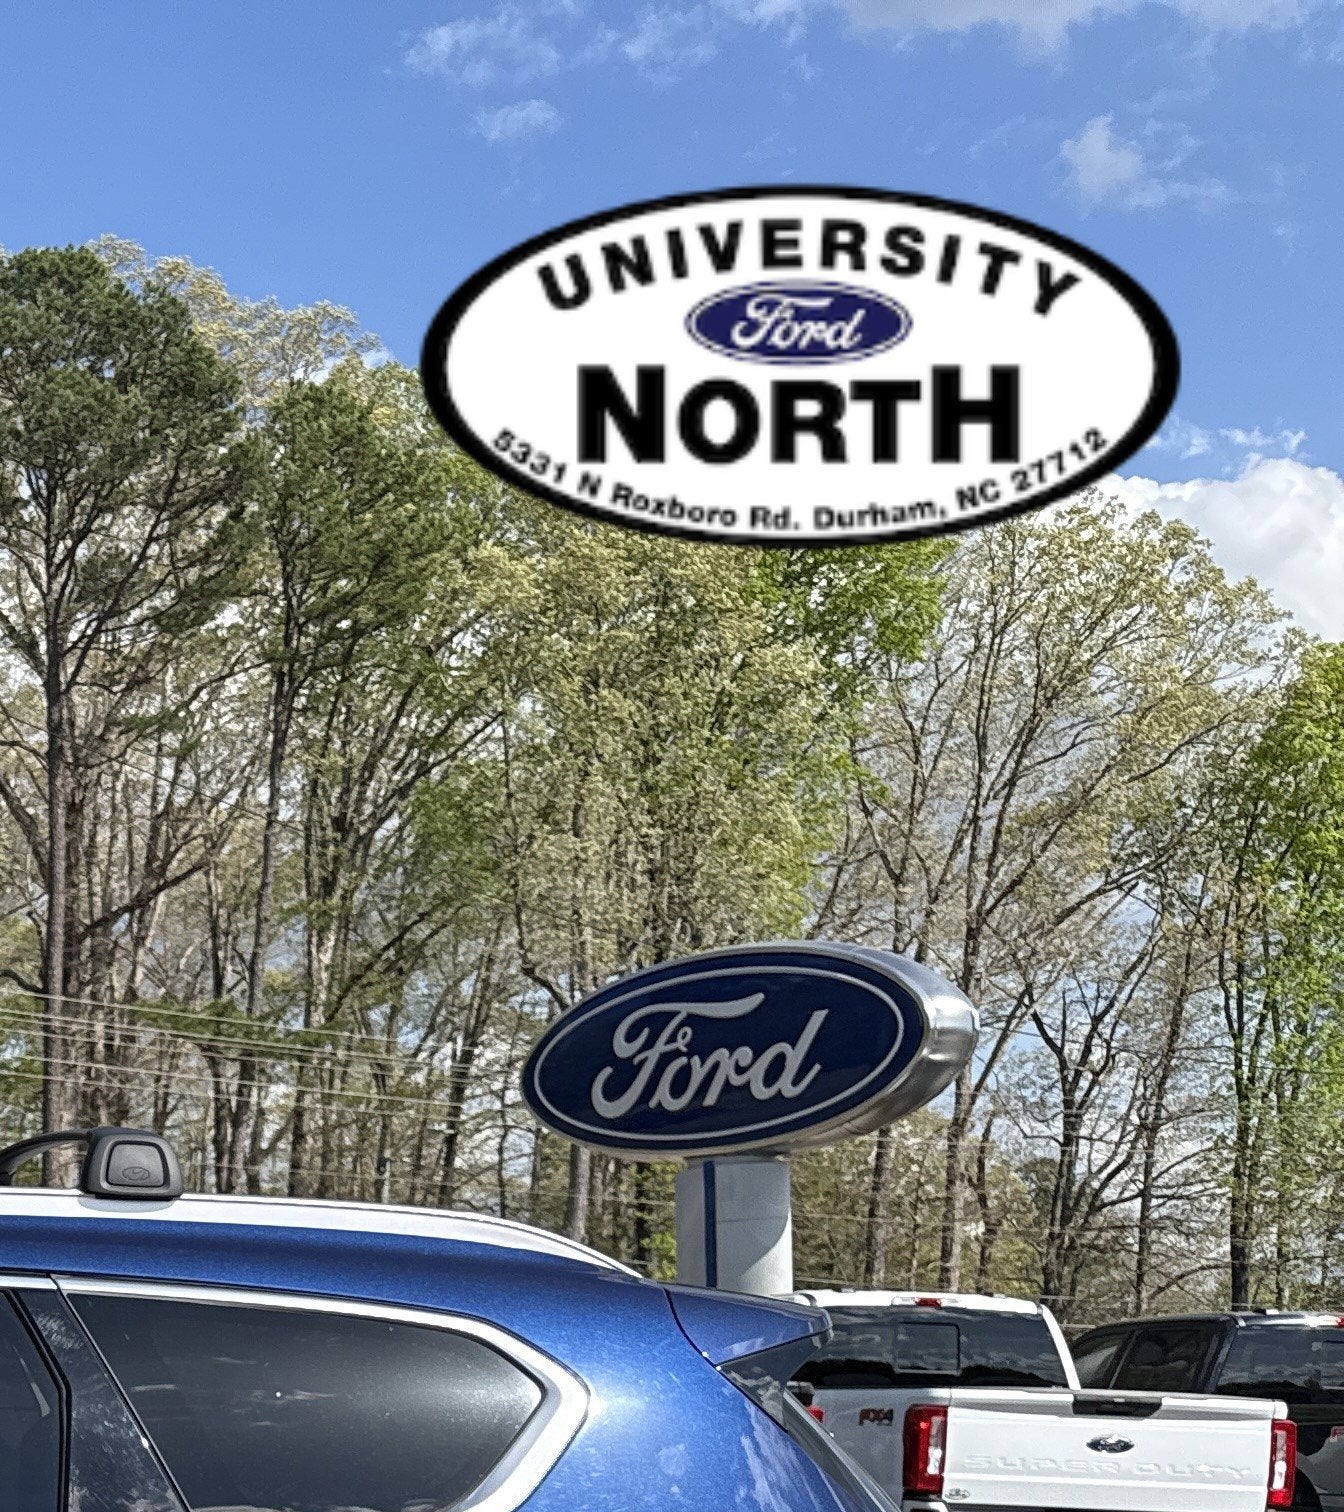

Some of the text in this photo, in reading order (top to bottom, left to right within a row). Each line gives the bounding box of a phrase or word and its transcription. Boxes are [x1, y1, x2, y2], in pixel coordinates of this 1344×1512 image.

[591, 992, 830, 1120] Ford
[962, 1454, 1252, 1479] SUPER DUTY
